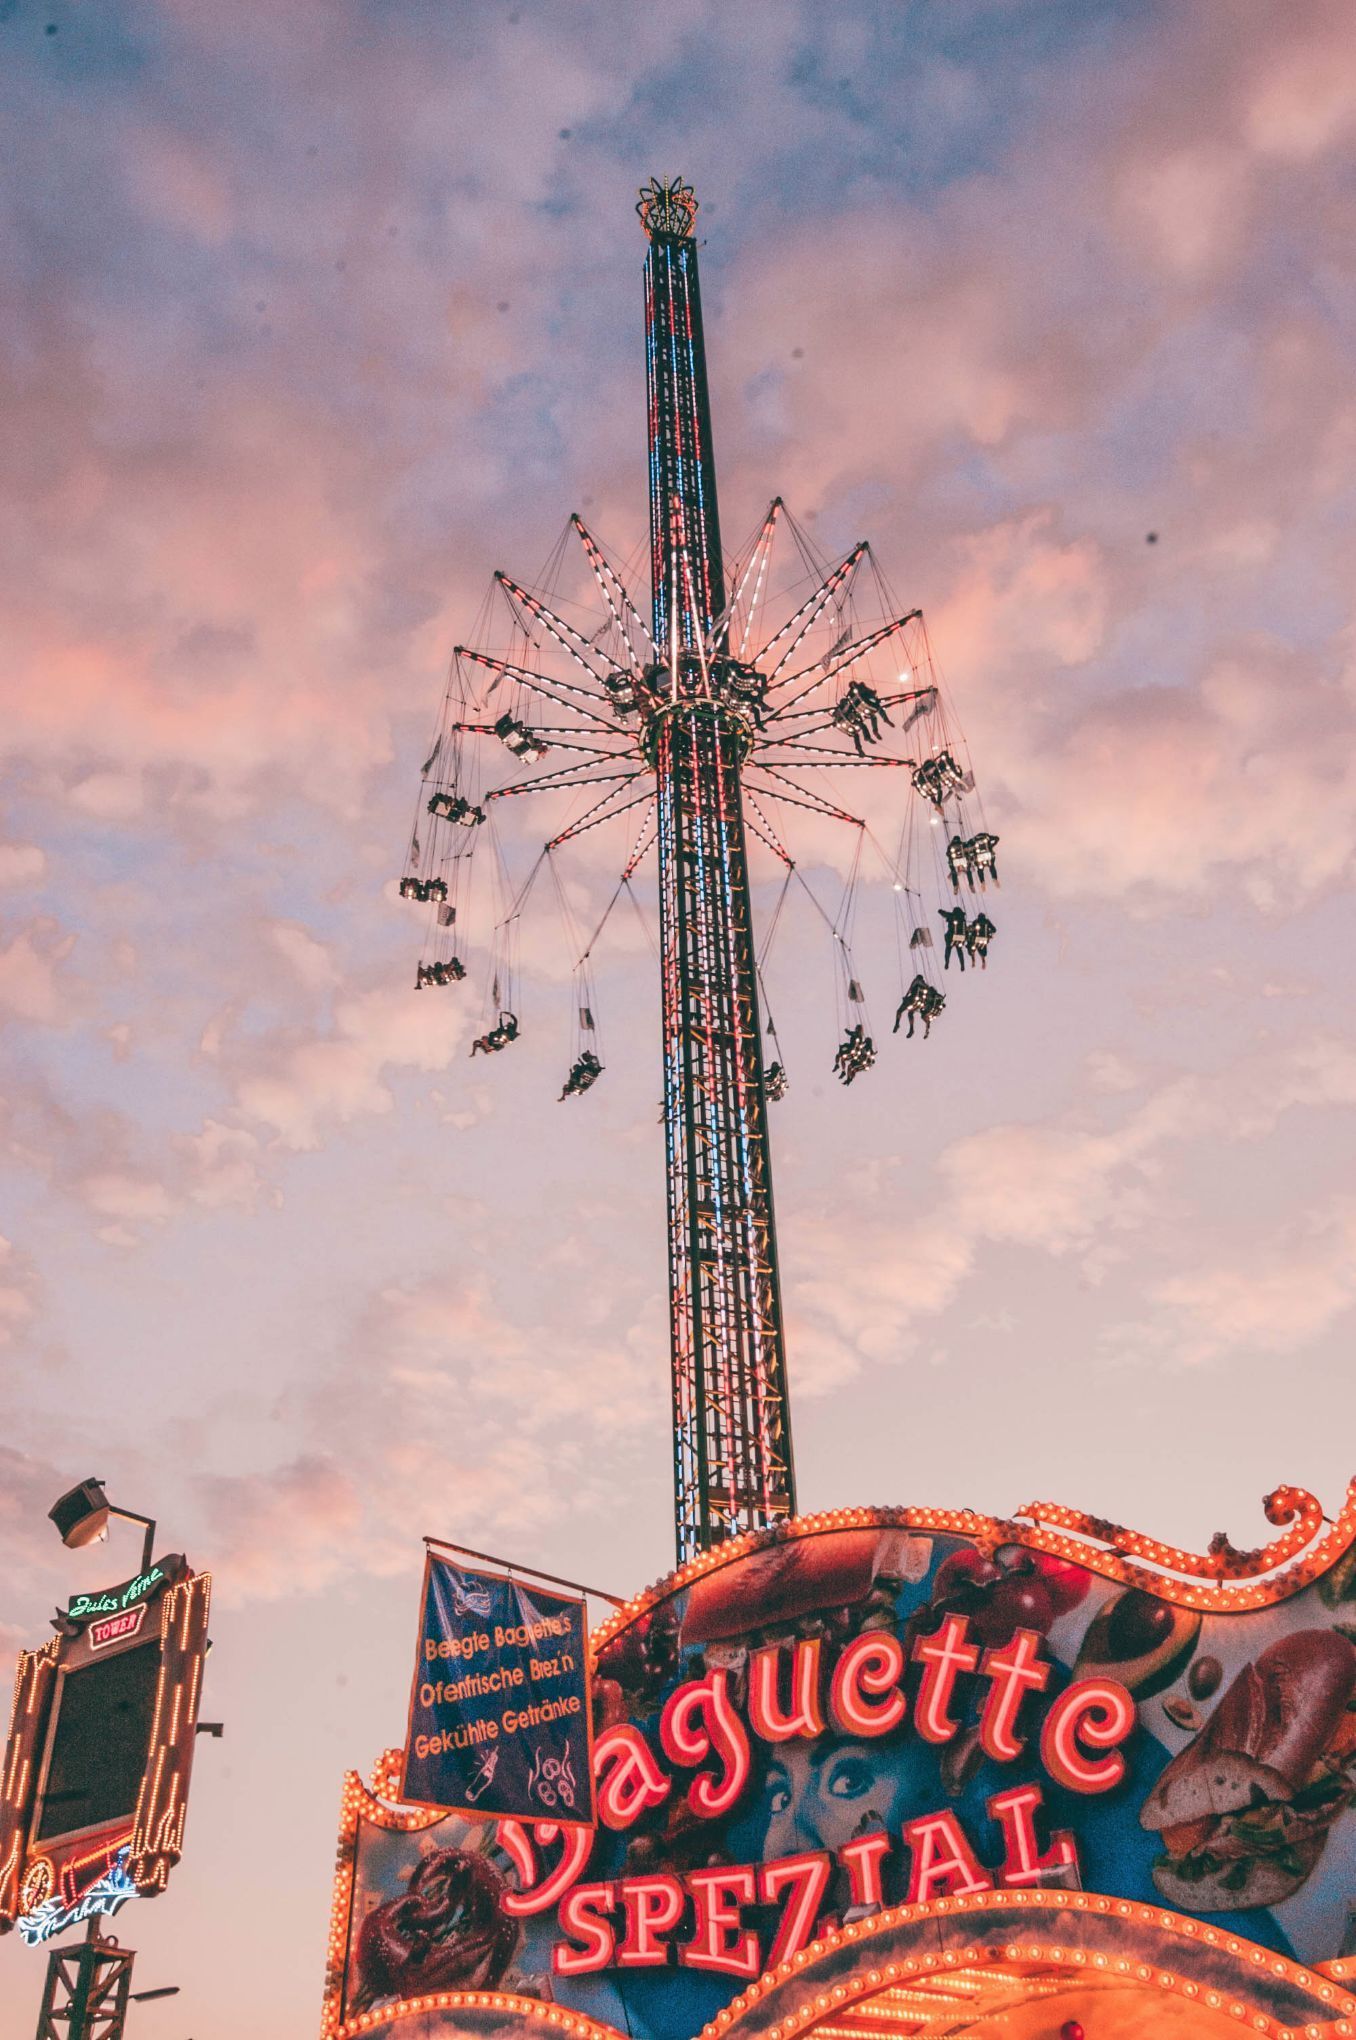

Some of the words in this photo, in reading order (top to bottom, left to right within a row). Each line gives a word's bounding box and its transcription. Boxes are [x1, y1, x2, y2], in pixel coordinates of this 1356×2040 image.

[69, 1594, 118, 1617] Jules
[122, 1568, 164, 1608] Verne
[95, 1613, 138, 1642] TOWER
[420, 1666, 524, 1708] Ofenfrische
[530, 1650, 574, 1681] Brez'n
[415, 1719, 499, 1759] Gekühlte
[502, 1695, 581, 1734] Getränke
[553, 1782, 1081, 1979] SPEZIAL
